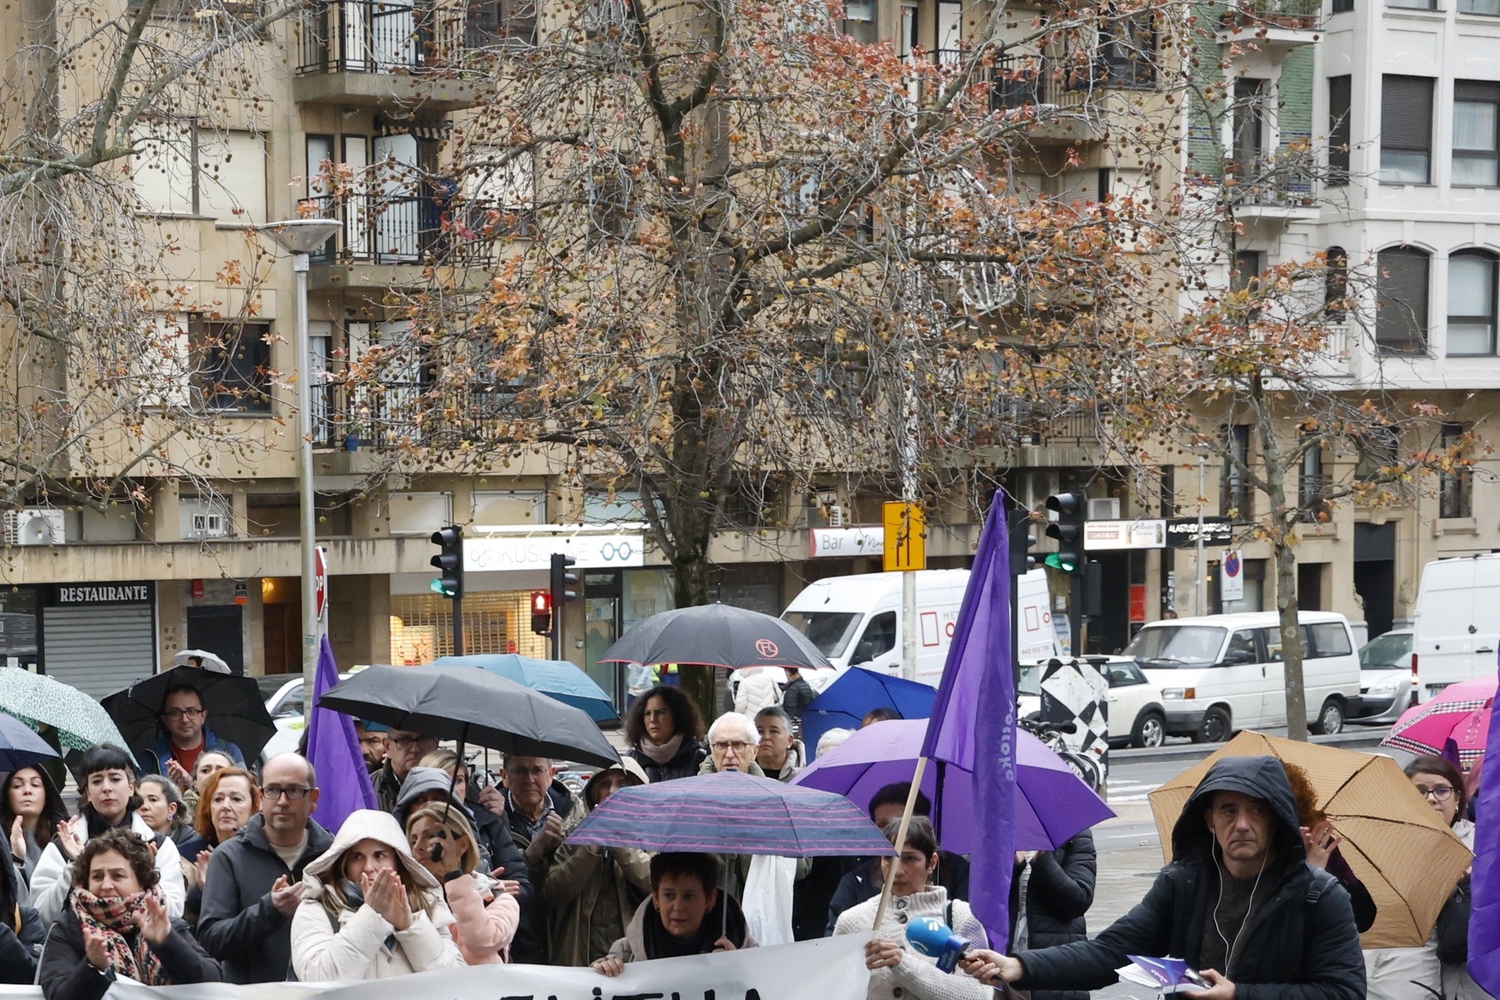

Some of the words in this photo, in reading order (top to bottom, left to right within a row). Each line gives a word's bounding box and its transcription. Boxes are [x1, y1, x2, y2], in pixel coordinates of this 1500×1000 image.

[822, 535, 844, 550] Bar
[498, 543, 589, 564] IKUSGNE
[60, 585, 147, 602] RESTAURANTE
